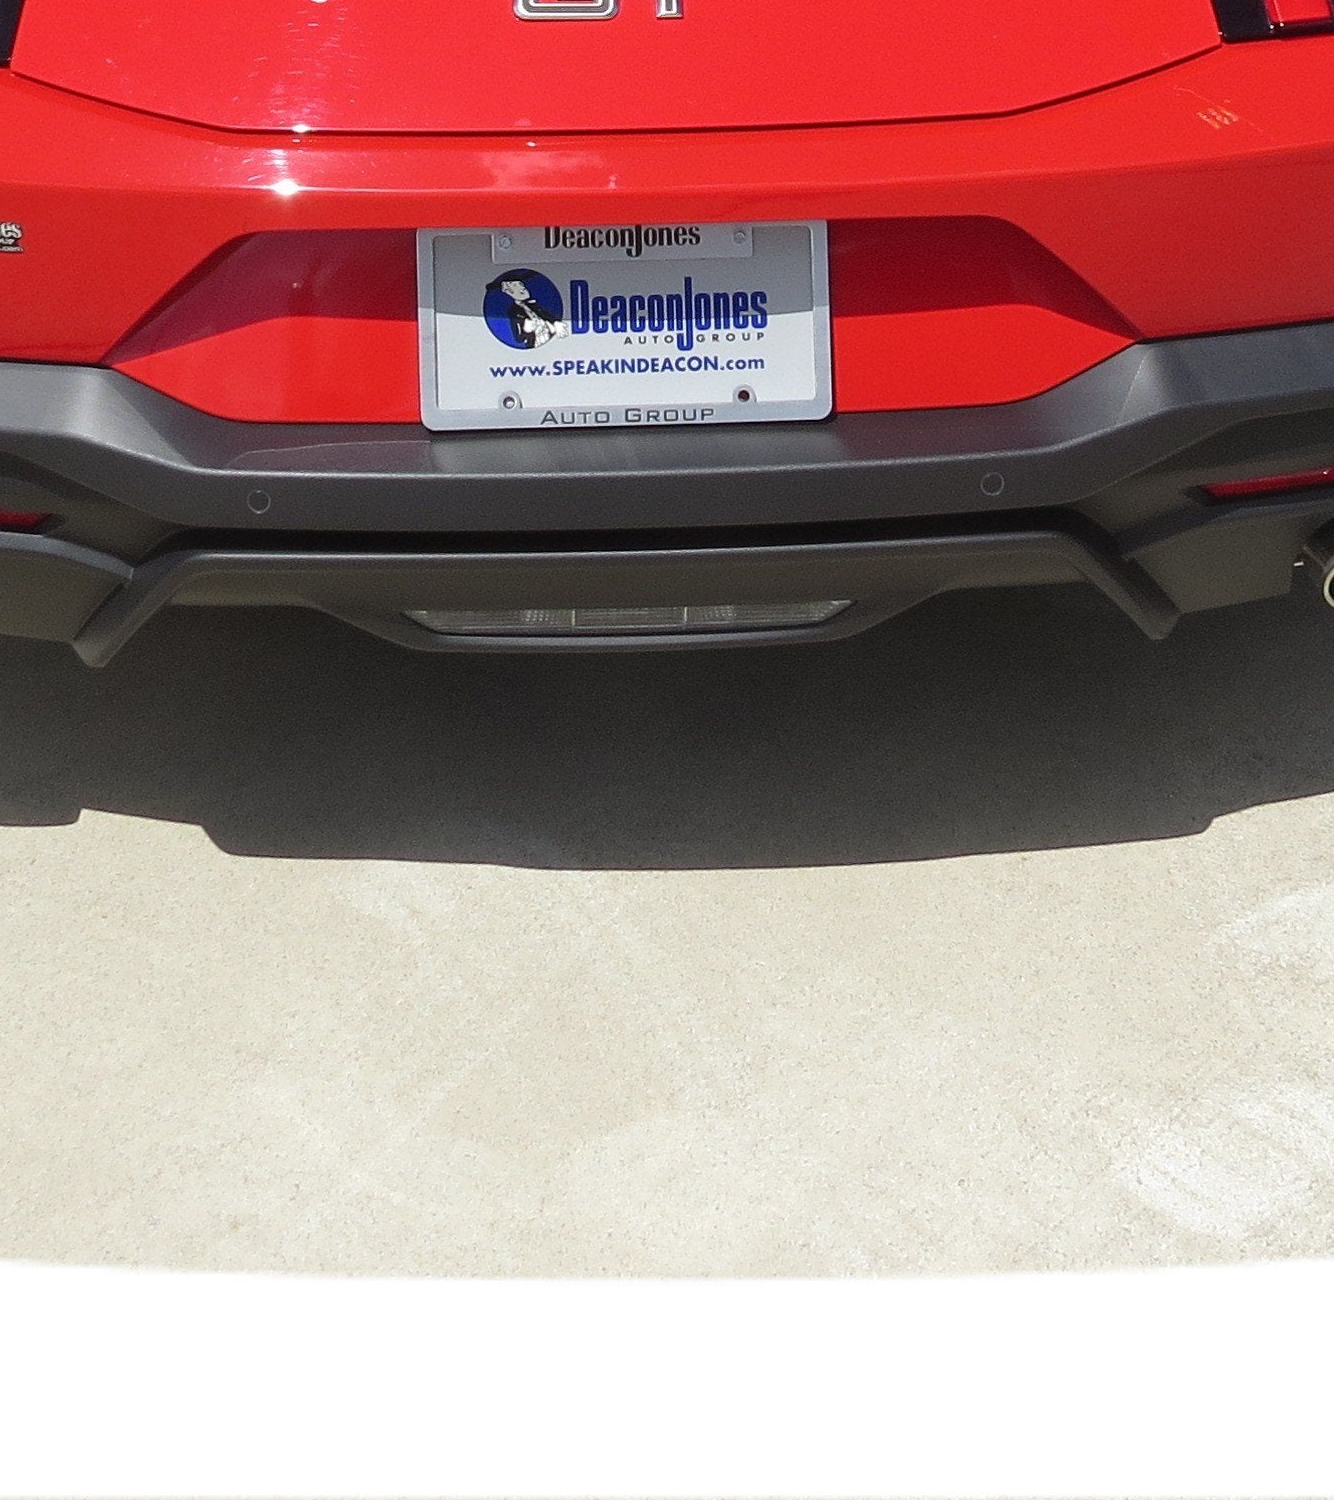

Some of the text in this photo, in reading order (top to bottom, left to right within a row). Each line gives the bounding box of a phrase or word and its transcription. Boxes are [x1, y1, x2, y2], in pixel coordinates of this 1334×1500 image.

[623, 331, 765, 346] AUTO GROUP
[488, 355, 765, 378] www.SPEAKINDEACON.com
